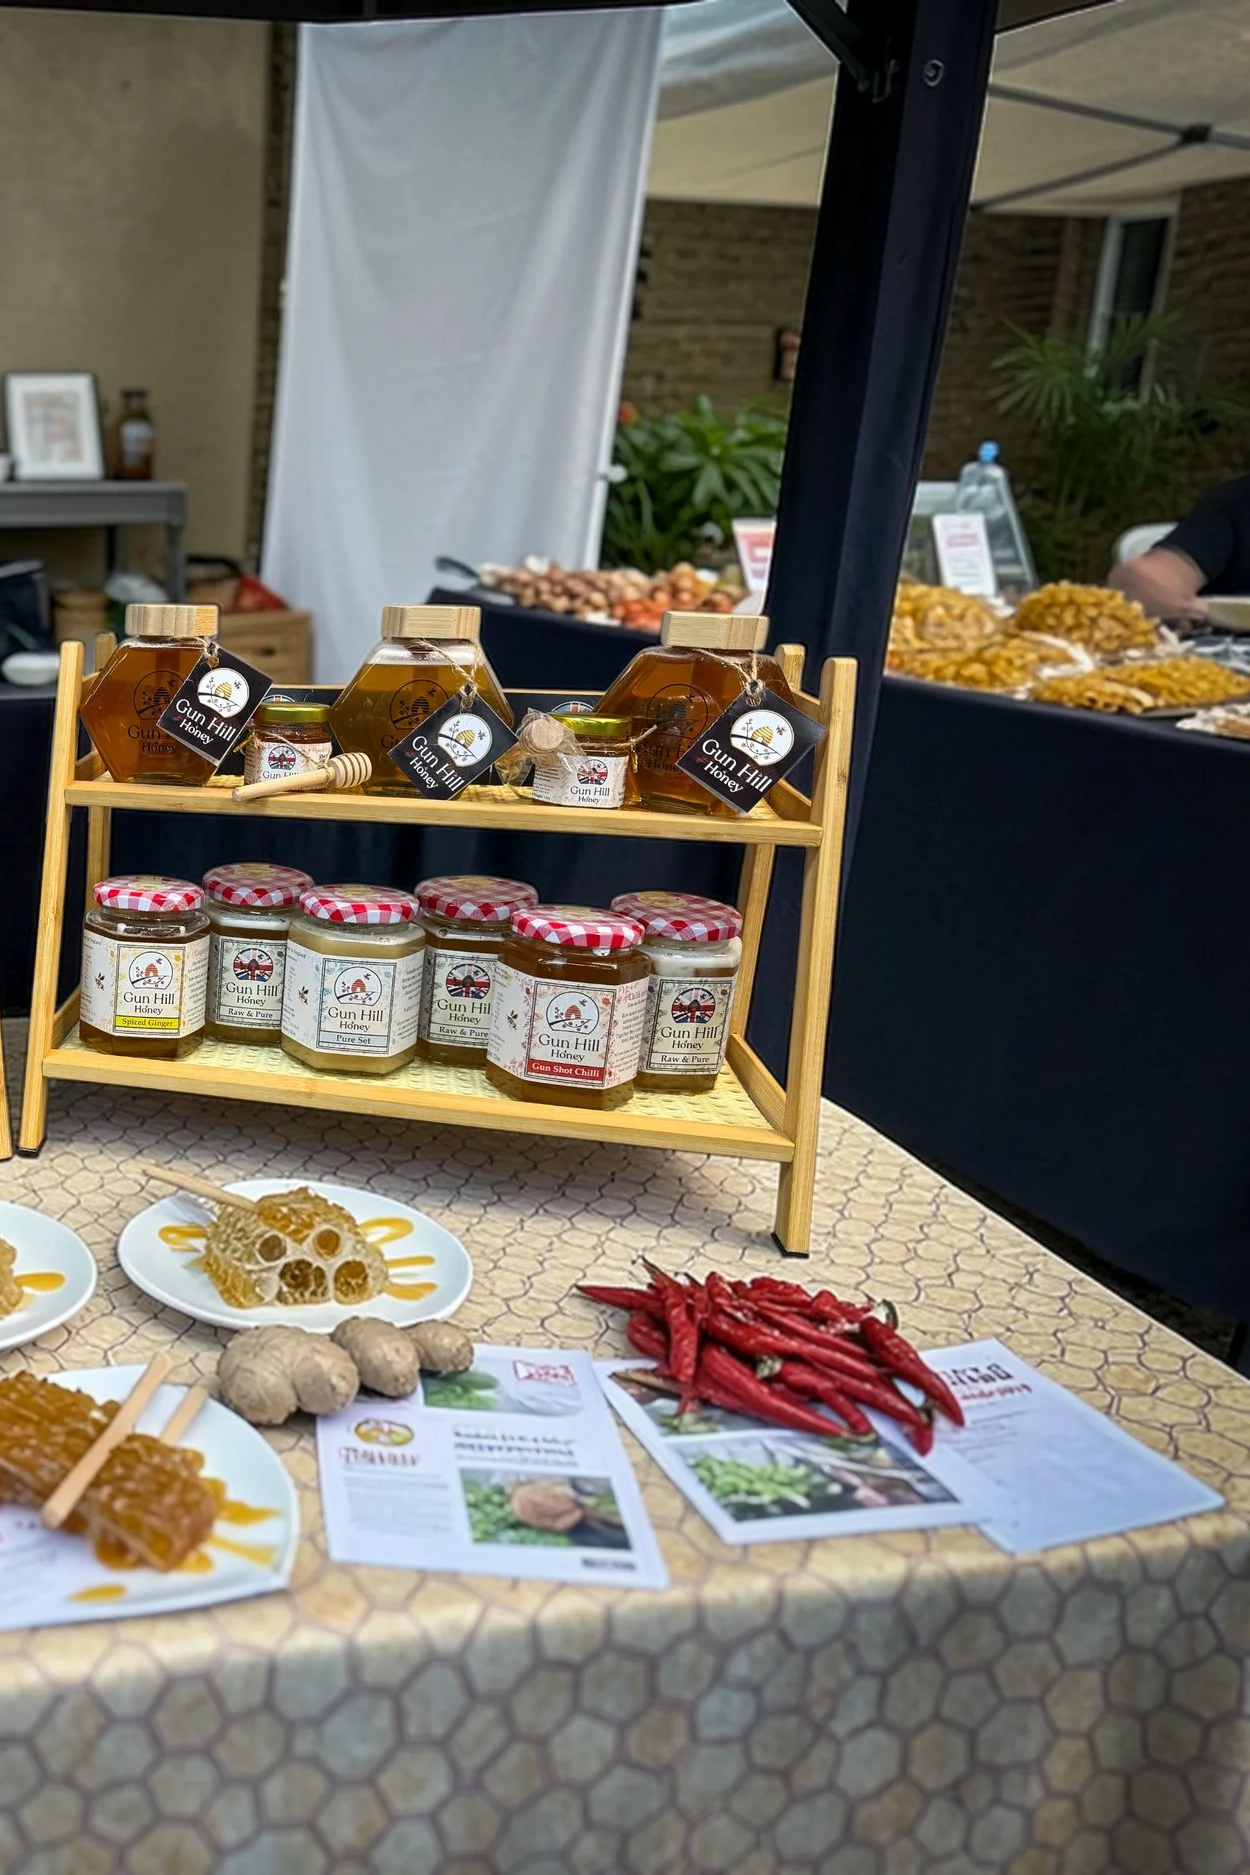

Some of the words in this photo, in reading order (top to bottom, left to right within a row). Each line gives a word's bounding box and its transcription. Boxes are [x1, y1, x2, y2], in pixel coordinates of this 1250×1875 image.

[175, 699, 208, 726] Gun
[207, 716, 237, 742] Hill
[127, 725, 161, 740] Gun
[179, 718, 214, 746] Honey
[412, 735, 439, 769] Gun
[435, 762, 465, 793] Hill
[702, 739, 738, 771] Gun
[737, 763, 773, 794] Hill
[262, 770, 282, 780] Gun
[409, 756, 439, 790] Honey
[704, 761, 744, 794] Honey
[570, 785, 591, 796] Gun
[593, 786, 610, 797] Hill
[578, 795, 601, 805] Honey
[225, 981, 253, 995] Gun
[256, 985, 278, 997] Hill
[123, 991, 150, 1005] Gun
[154, 993, 175, 1005] Hill
[236, 995, 266, 1007] Honey
[134, 1005, 163, 1016] Honey
[437, 998, 467, 1013] Gun
[471, 1002, 491, 1015] Hil
[228, 1008, 244, 1016] Raw
[246, 1010, 253, 1018] &
[255, 1011, 273, 1019] Pure
[328, 1006, 357, 1020] Gun
[360, 1009, 384, 1022] Hill
[449, 1013, 482, 1025] Honey
[122, 1018, 146, 1026] Spiced
[148, 1019, 174, 1028] Ginger
[339, 1020, 371, 1033] Honey
[439, 1026, 457, 1035] Raw
[459, 1028, 467, 1036] &
[469, 1029, 489, 1038] Pure
[660, 1026, 691, 1039] Gun
[694, 1026, 718, 1039] Hill
[336, 1034, 356, 1044] Pure
[357, 1036, 371, 1045] Set
[538, 1033, 570, 1049] Gun
[574, 1037, 600, 1052] Hill
[671, 1040, 704, 1051] Honey
[550, 1049, 585, 1062] Honey
[660, 1055, 680, 1063] Raw
[691, 1055, 710, 1063] Pure
[532, 1062, 552, 1072] Gun
[553, 1065, 573, 1075] Shot
[574, 1068, 600, 1078] Chilli
